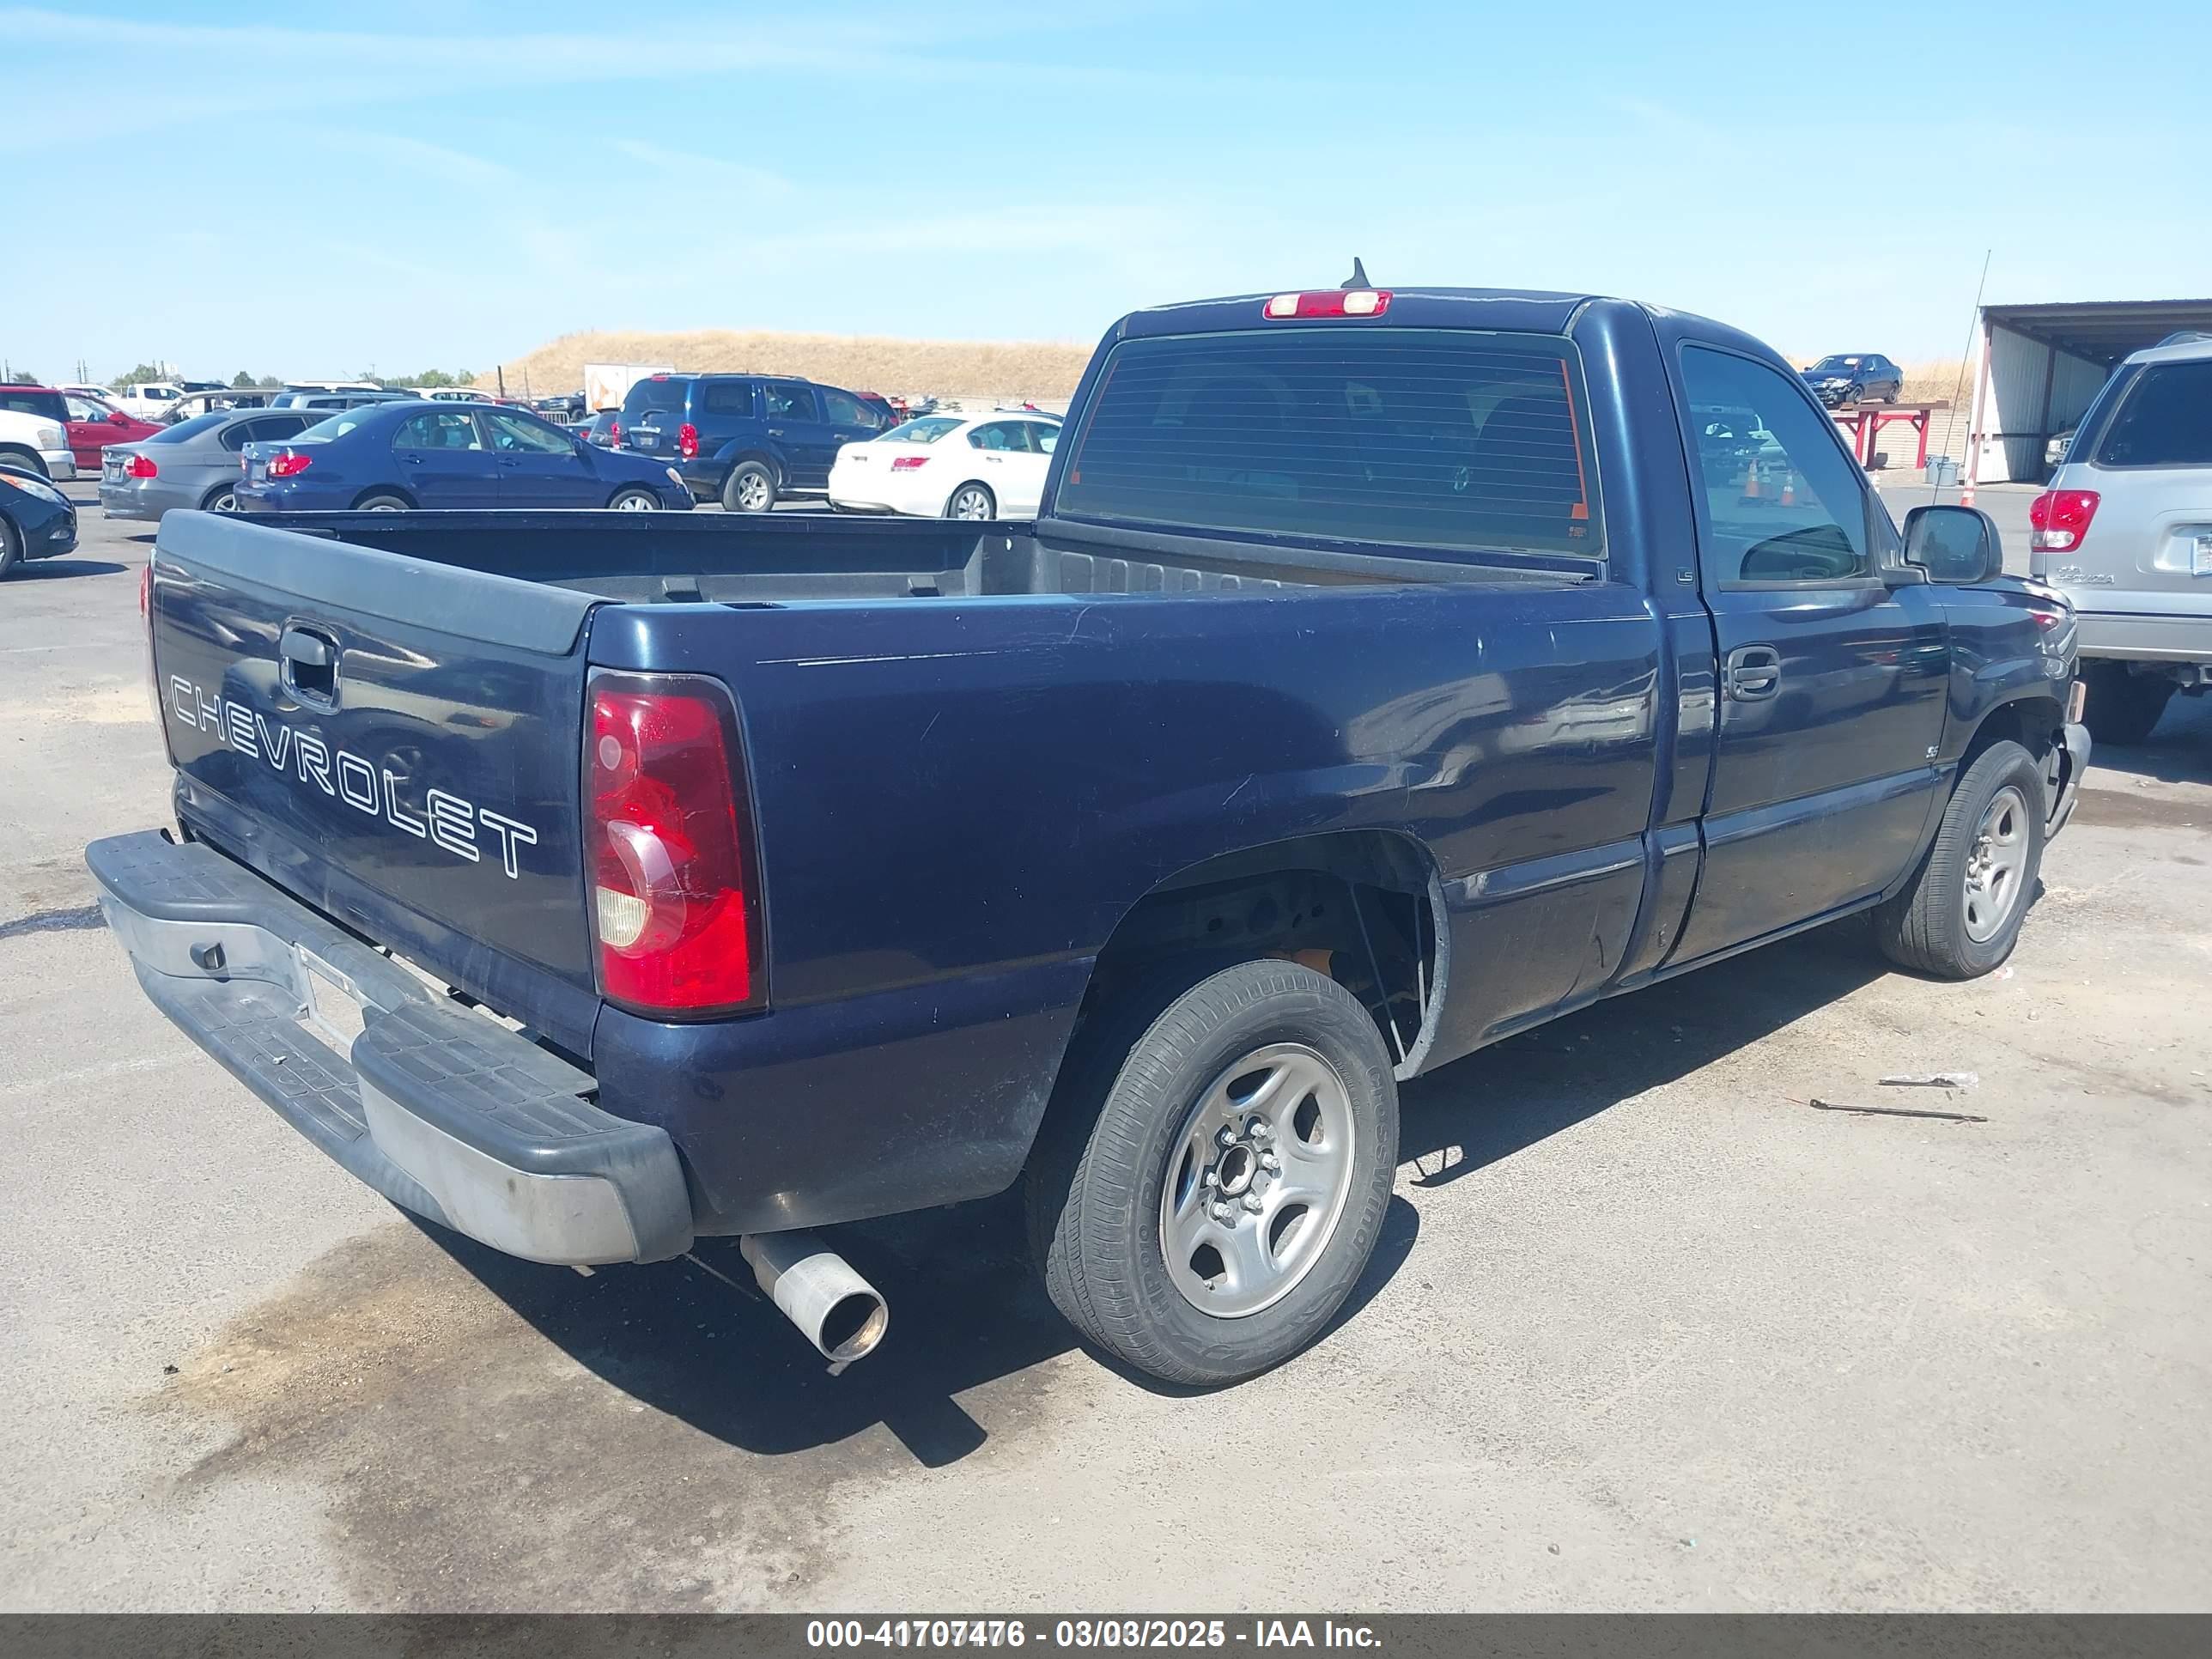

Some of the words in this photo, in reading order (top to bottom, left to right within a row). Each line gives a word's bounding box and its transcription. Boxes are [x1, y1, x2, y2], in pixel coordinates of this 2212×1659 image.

[1677, 569, 1693, 582] LS
[171, 674, 538, 879] CHEVROLET
[1139, 1103, 1181, 1210] PLUS
[1352, 1065, 1390, 1259] CrossWind
